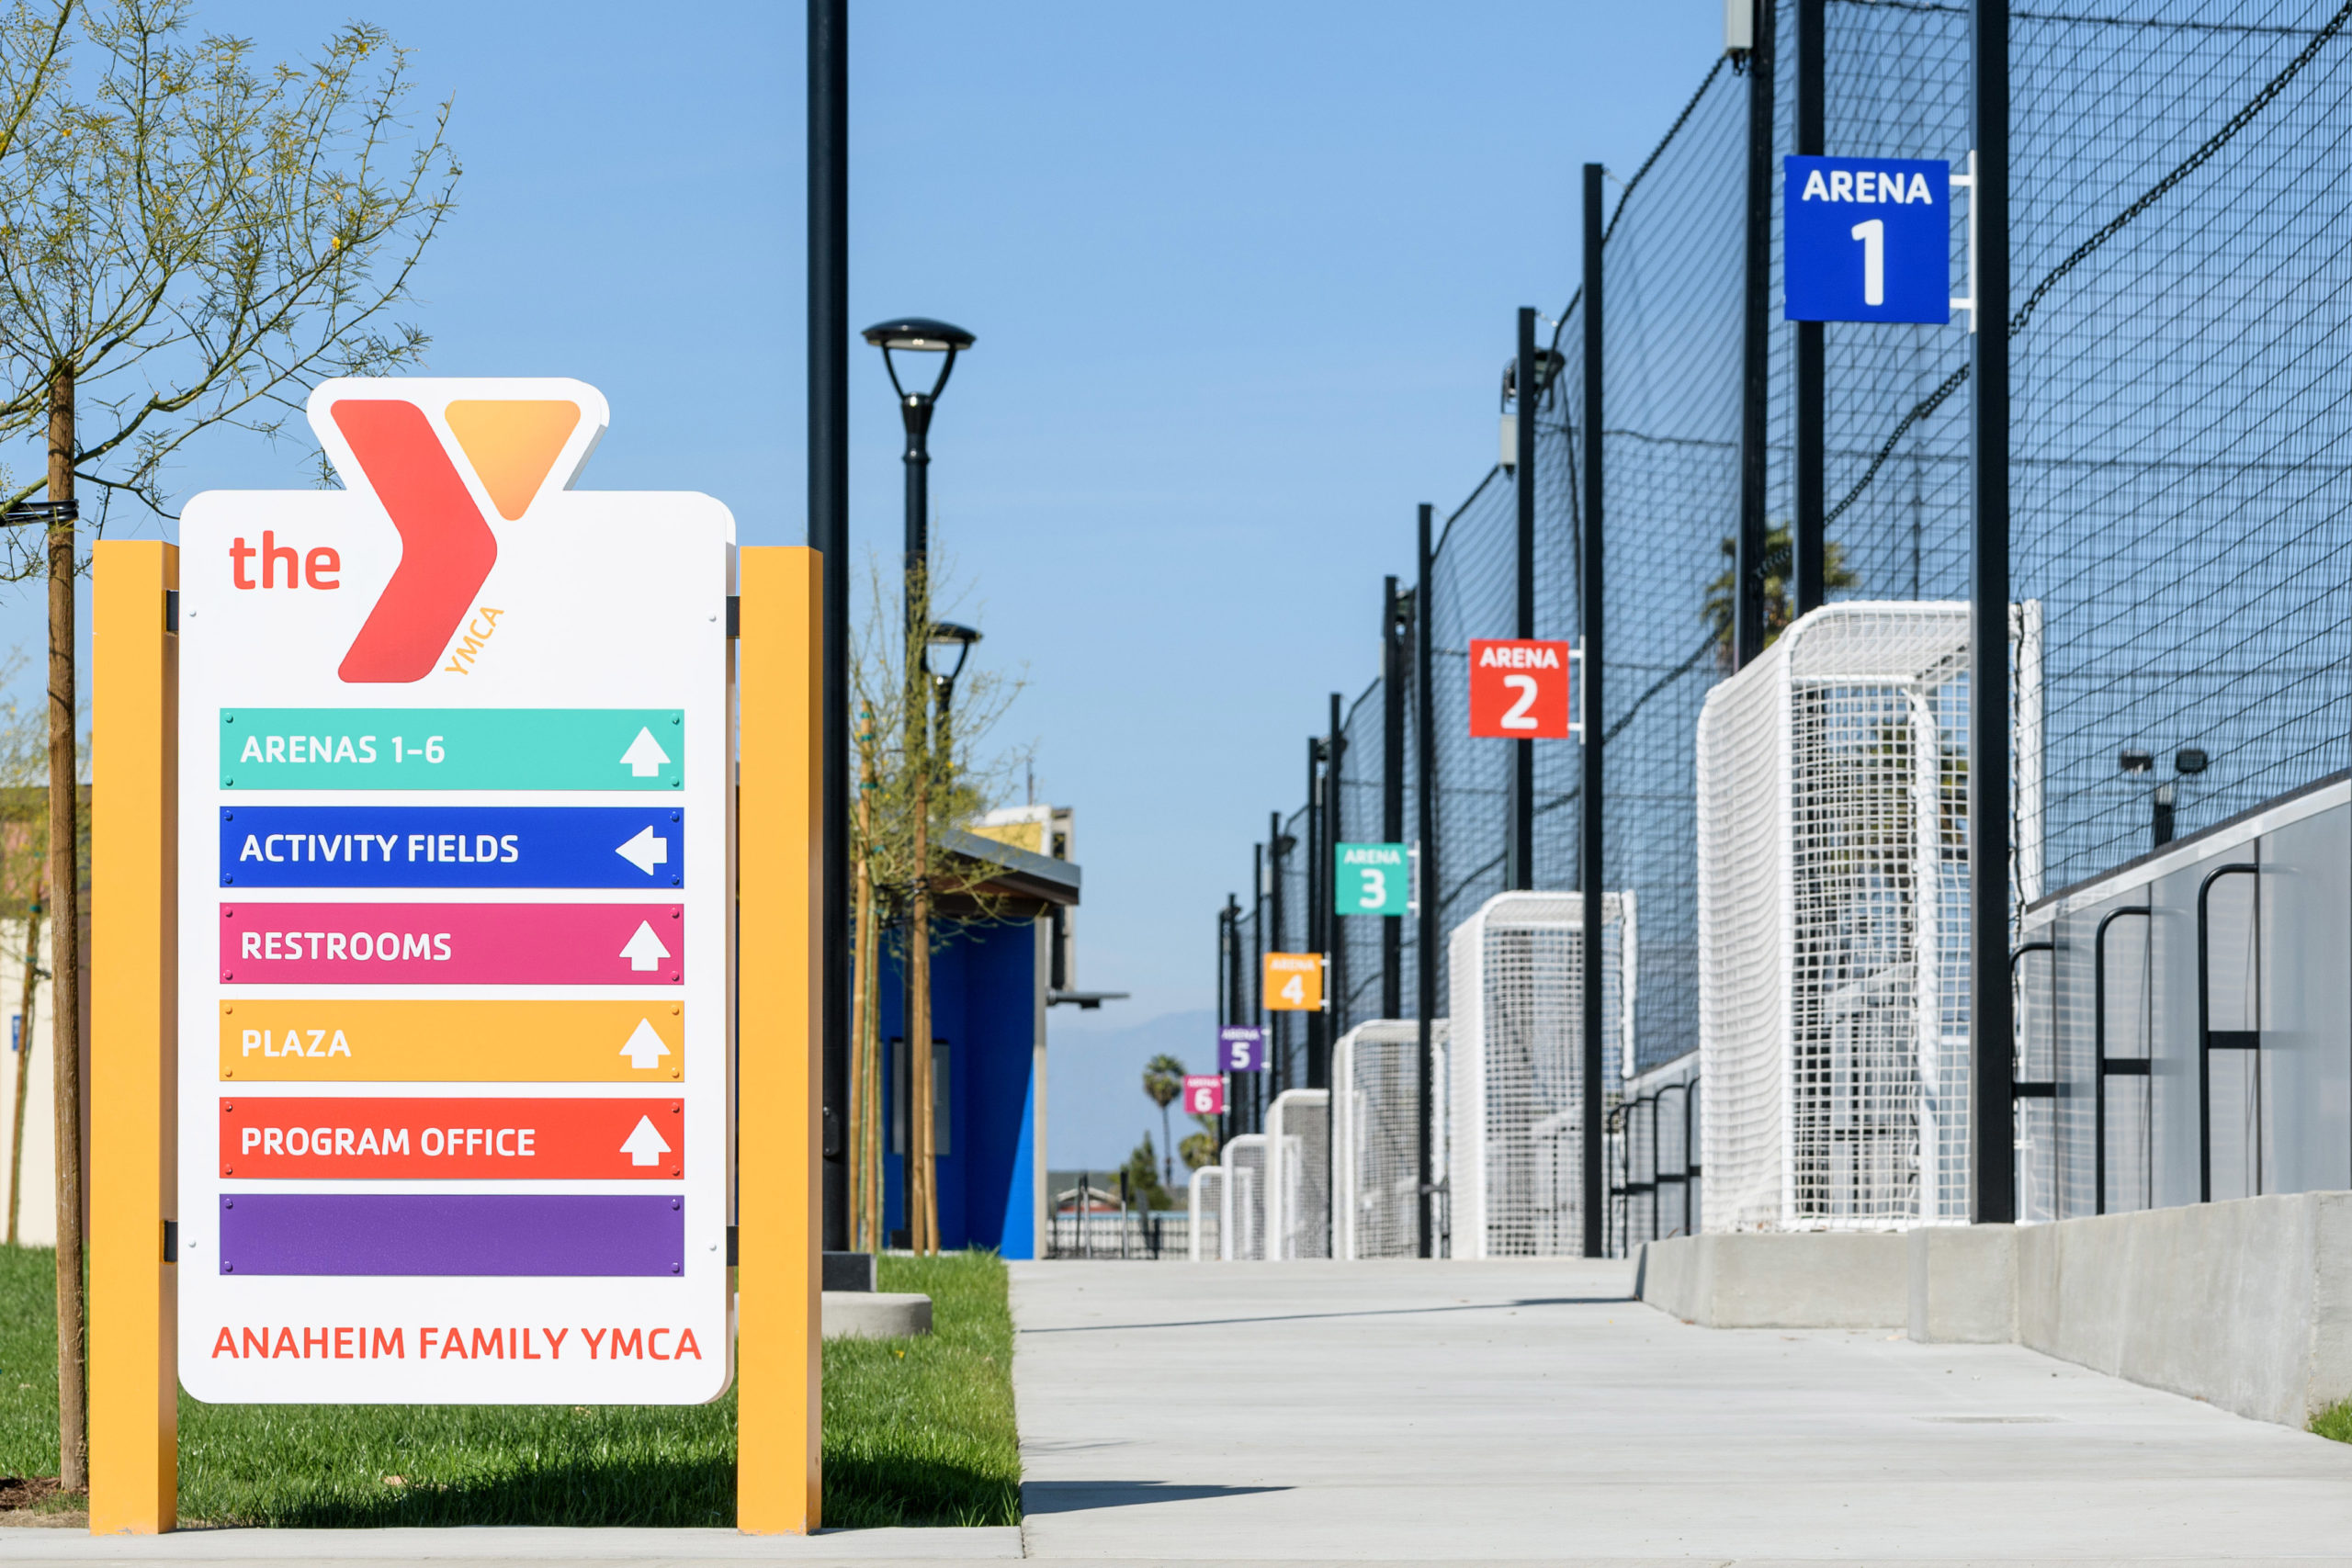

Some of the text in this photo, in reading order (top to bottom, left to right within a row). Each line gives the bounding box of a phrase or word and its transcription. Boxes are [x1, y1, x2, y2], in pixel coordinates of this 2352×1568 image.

[1802, 169, 1933, 205] ARENA
[1851, 219, 1884, 306] 1
[229, 530, 341, 591] the
[445, 605, 504, 675] YMCA
[1479, 647, 1559, 670] ARENA
[1500, 674, 1538, 729] 2
[240, 735, 377, 763] ARENAS
[239, 833, 519, 863] ACTIVITY FIELDS
[1344, 849, 1401, 864] ARENA
[1359, 868, 1386, 908] 3
[242, 931, 452, 961] RESTROOMS
[1271, 958, 1315, 971] ARENA
[1281, 974, 1305, 1005] 4
[242, 1029, 352, 1057] PLAZA
[1230, 1042, 1250, 1069] 5
[1194, 1088, 1213, 1112] 6
[242, 1127, 536, 1156] PROGRAM OFFICE
[211, 1326, 702, 1360] ANAHEIM FAMILY YMCA
